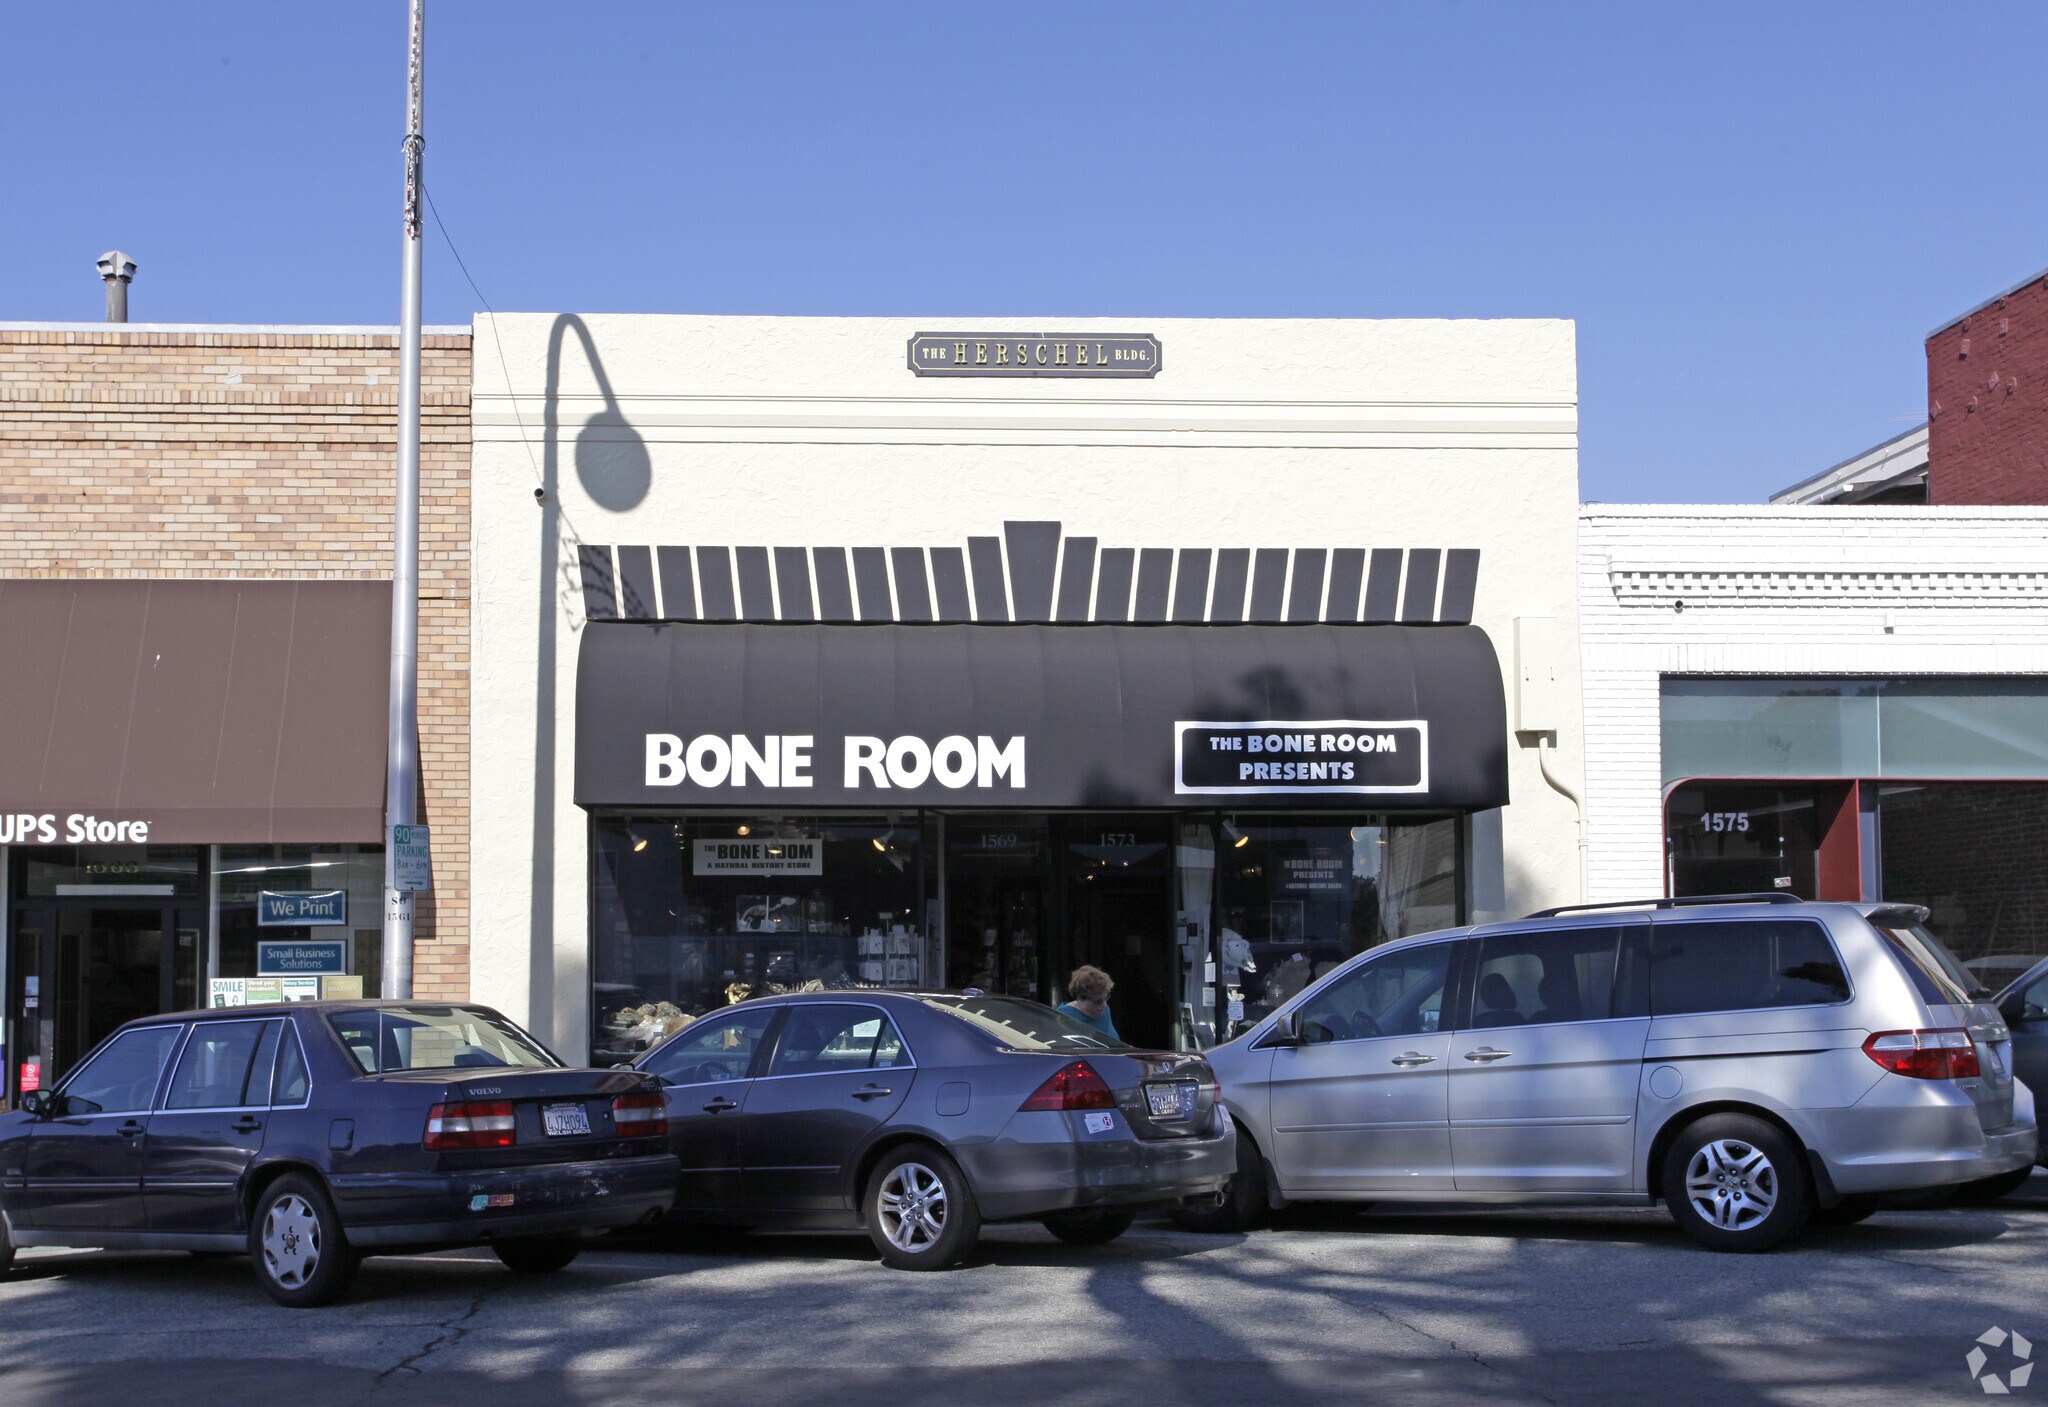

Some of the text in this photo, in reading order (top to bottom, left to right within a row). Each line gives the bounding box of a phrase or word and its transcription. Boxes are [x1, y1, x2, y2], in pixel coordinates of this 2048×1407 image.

[922, 343, 1150, 366] THE HERSCHEL BLDG.
[1210, 733, 1397, 753] THE BONE ROOM
[645, 733, 1026, 789] BONE ROOM
[1239, 762, 1355, 780] PRESENTS
[0, 813, 148, 843] UPS Store
[1700, 812, 1750, 832] 1575
[395, 827, 410, 842] 90
[981, 833, 1017, 848] 1569
[1100, 833, 1135, 847] 1573
[397, 845, 427, 858] PARKING
[717, 844, 760, 859] BONE
[270, 900, 335, 916] We Print
[267, 948, 336, 959] Small Business
[280, 959, 323, 969] Solutions
[212, 981, 244, 993] SMILE
[469, 1087, 501, 1096] VOLVO
